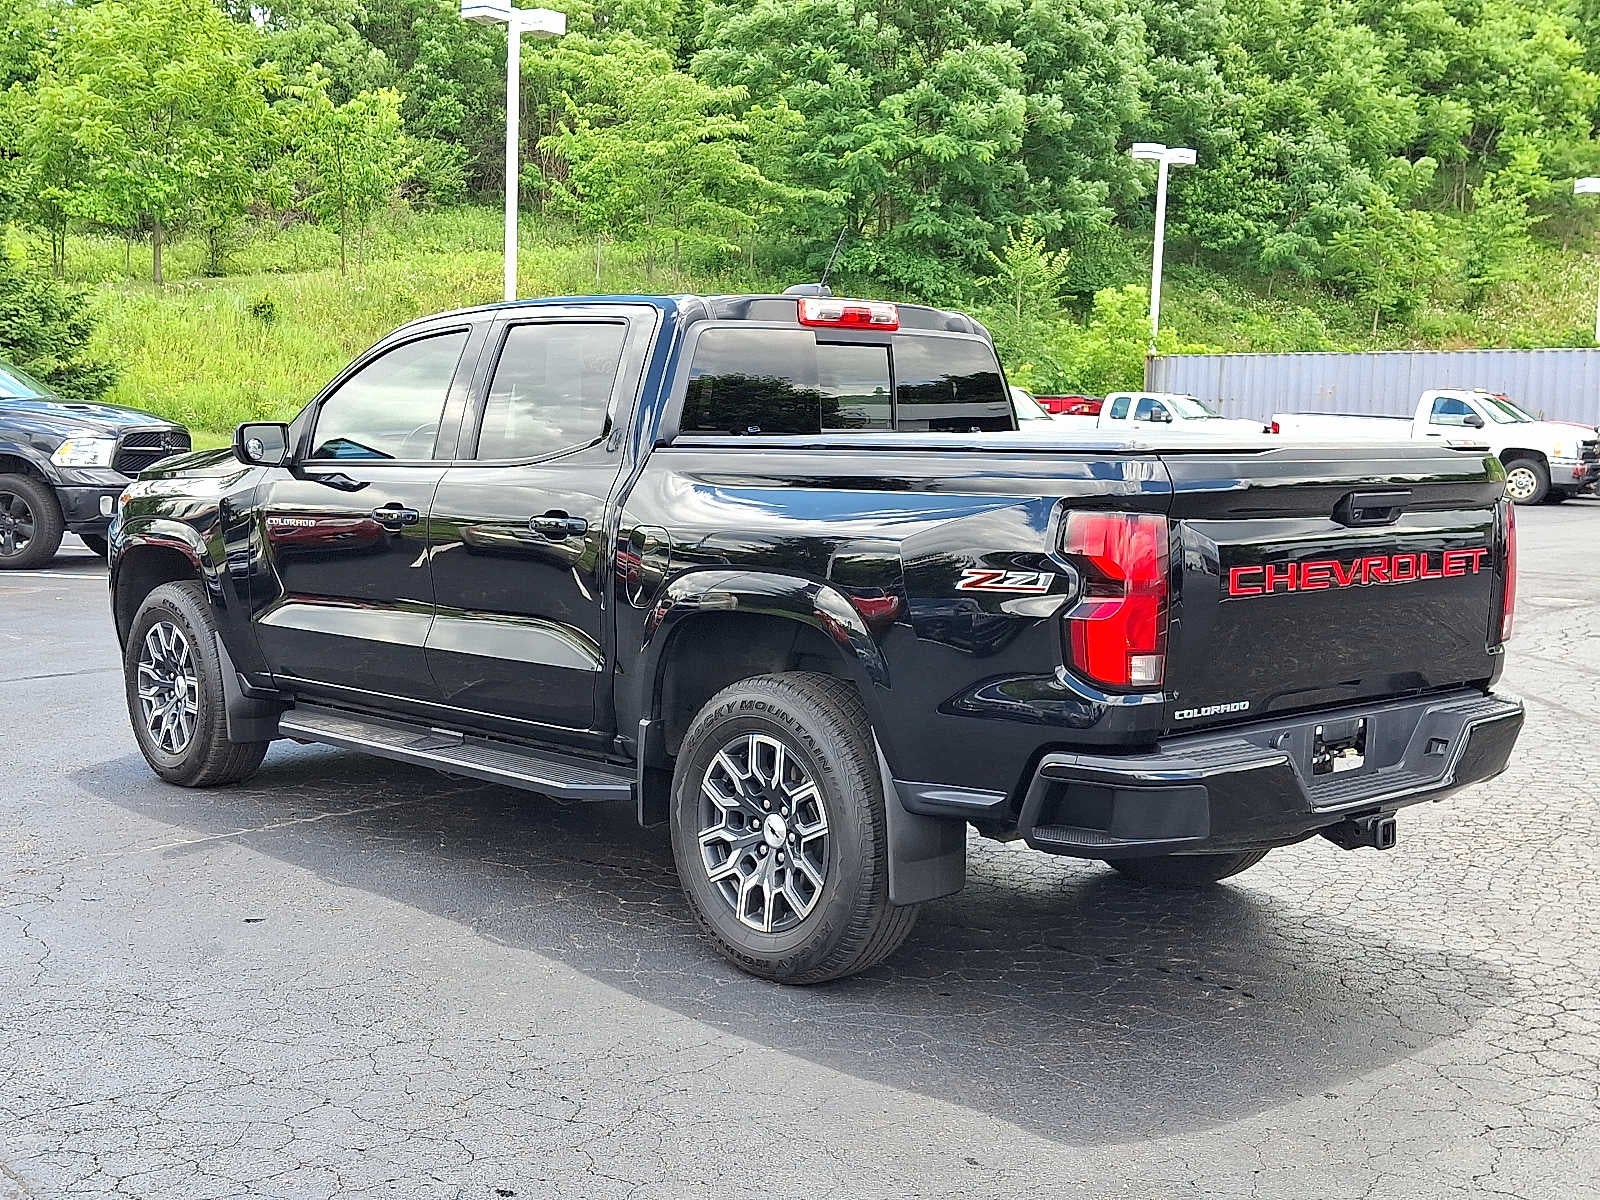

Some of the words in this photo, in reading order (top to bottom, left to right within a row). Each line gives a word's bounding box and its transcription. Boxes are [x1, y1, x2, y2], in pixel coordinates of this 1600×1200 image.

[267, 517, 316, 527] COLORADO
[955, 568, 1056, 594] Z71
[1229, 547, 1488, 596] CHEVROLET
[1174, 701, 1250, 720] COLORADO
[740, 700, 833, 774] MOUNTAIN
